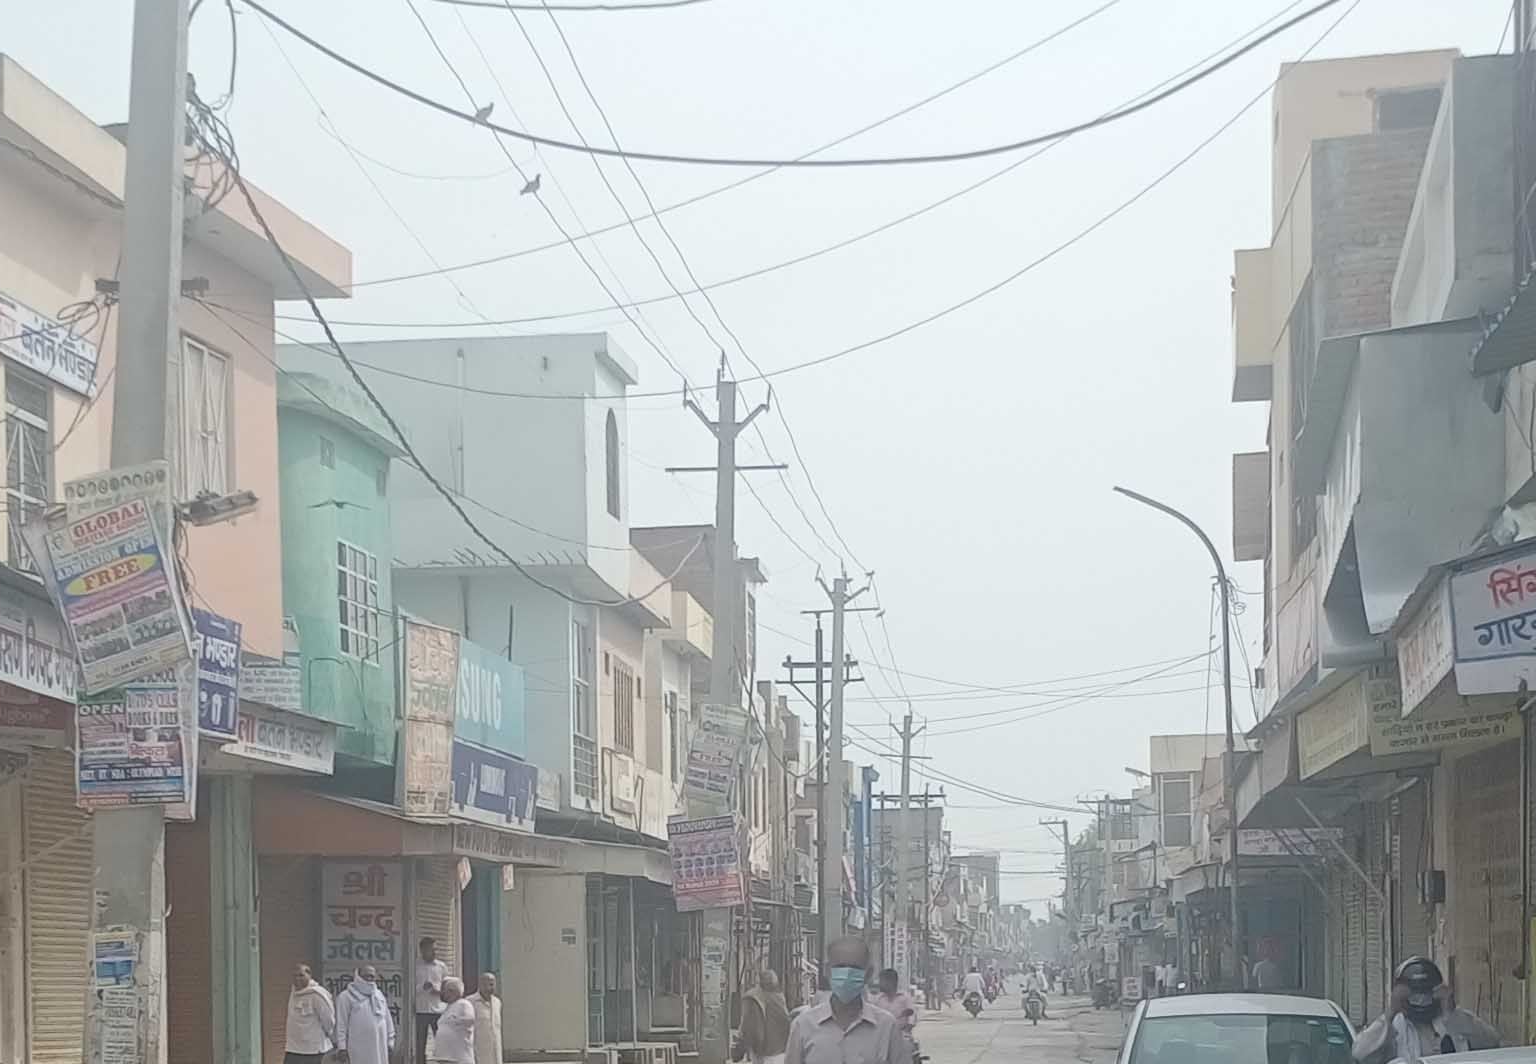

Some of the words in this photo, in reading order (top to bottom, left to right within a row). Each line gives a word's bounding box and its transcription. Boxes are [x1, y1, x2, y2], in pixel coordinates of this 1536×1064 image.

[74, 502, 145, 539] GLOBAL
[82, 557, 141, 592] FREE
[79, 704, 124, 716] OPEN
[460, 656, 502, 732] SUNG
[341, 863, 388, 897] श्री
